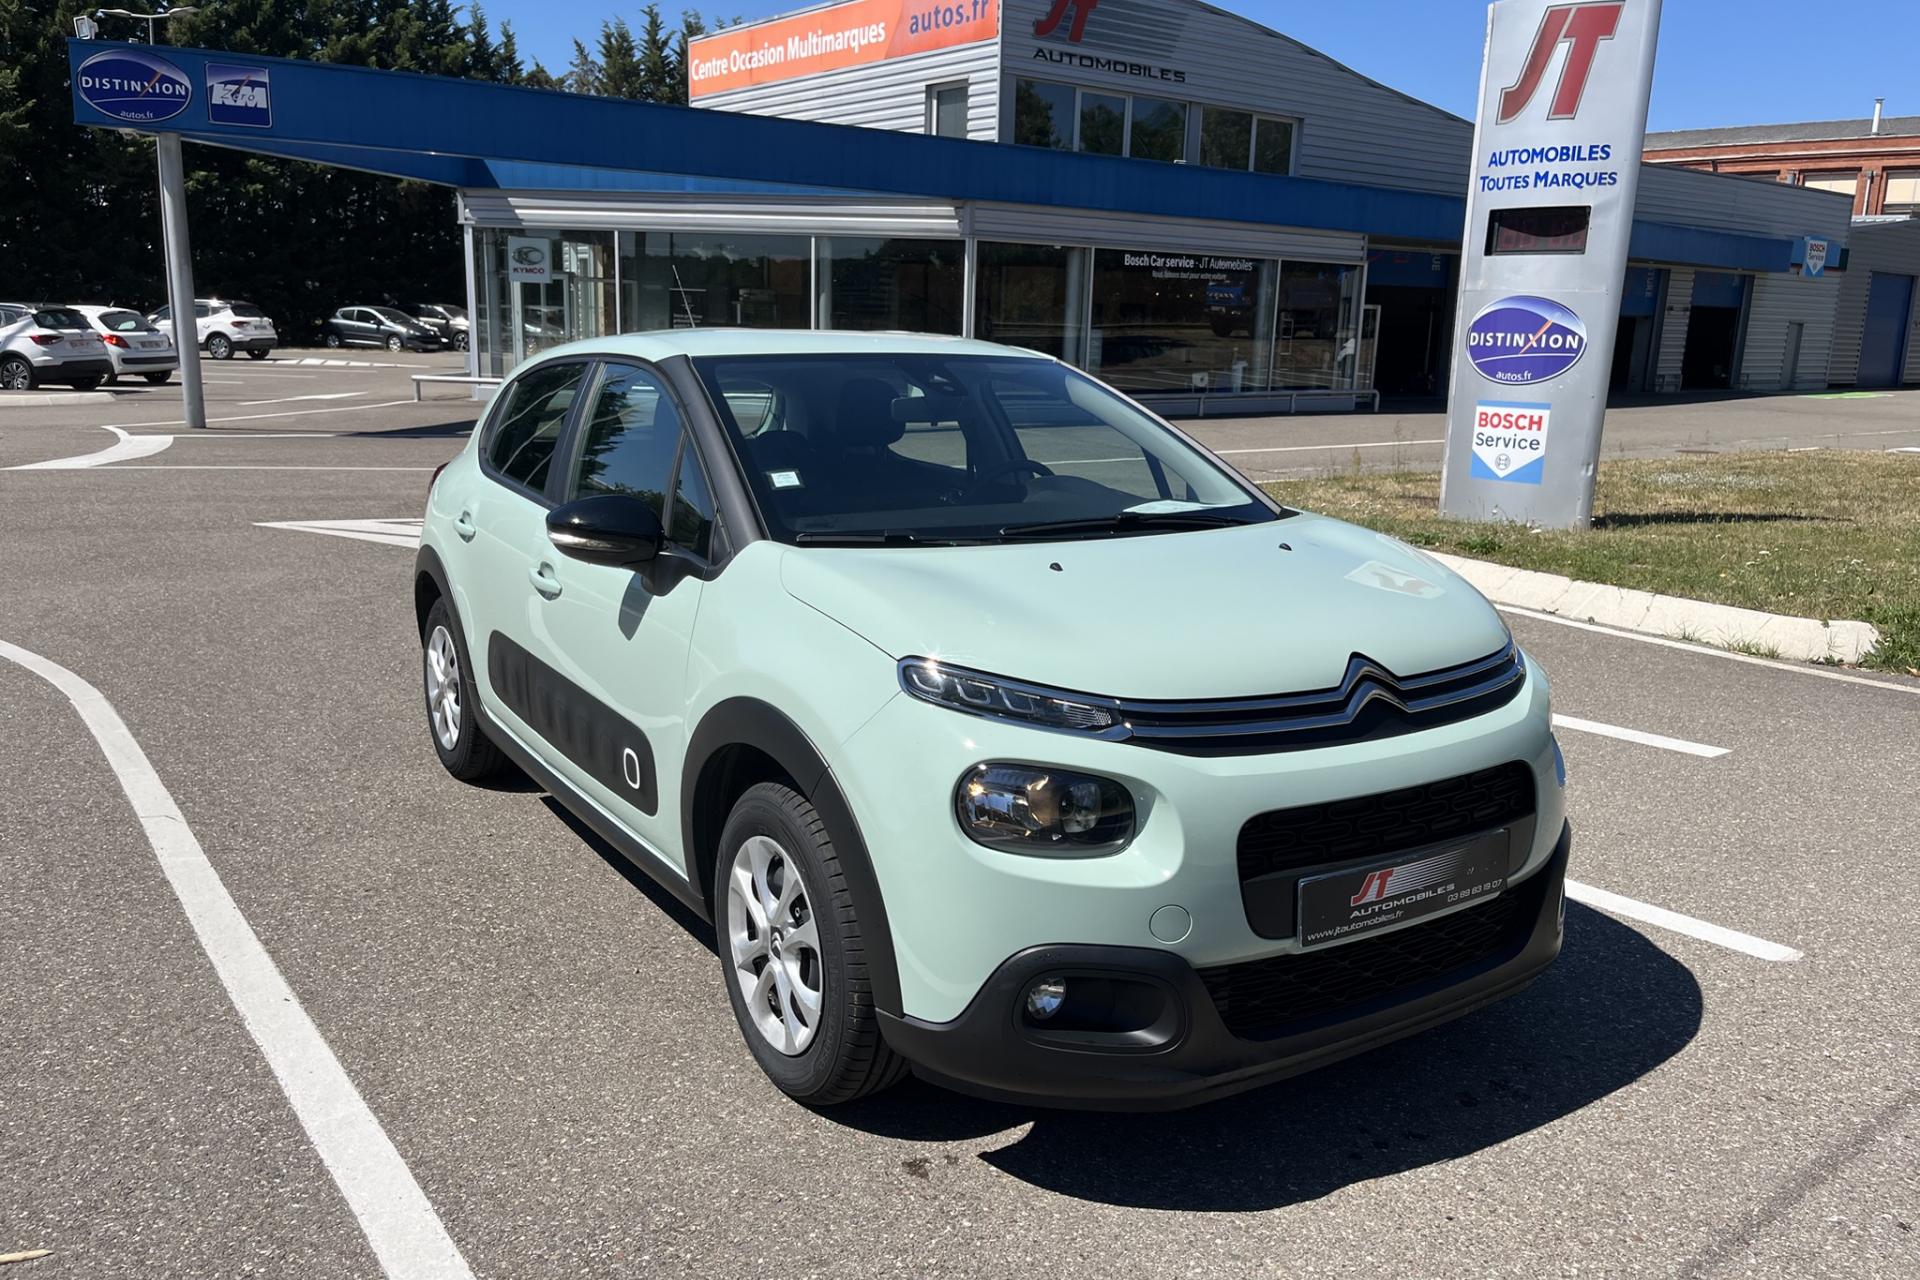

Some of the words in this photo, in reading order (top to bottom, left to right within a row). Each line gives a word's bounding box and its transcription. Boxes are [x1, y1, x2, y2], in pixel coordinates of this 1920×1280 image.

[909, 0, 989, 35] autos.fr
[691, 56, 728, 81] Centre
[730, 43, 784, 73] Occasion
[787, 21, 886, 61] Multimarques
[1496, 0, 1626, 125] JT
[1033, 48, 1186, 83] AUTOMOBILES
[81, 76, 187, 97] DISTINXION
[120, 109, 154, 120] autos.fr
[1488, 144, 1611, 168] AUTOMOBILES
[1124, 254, 1149, 266] Bosch
[1150, 255, 1165, 267] Car
[1165, 256, 1195, 268] service
[1199, 257, 1209, 269] JT
[1209, 258, 1253, 271] Automobiles
[1470, 330, 1579, 350] DISTINXION
[1496, 370, 1532, 382] autos.fr
[1478, 411, 1543, 432] BOSCH
[1475, 432, 1541, 451] Service
[1350, 868, 1395, 907] JT
[1447, 892, 1459, 903] 03
[1491, 879, 1503, 888] 07
[1350, 883, 1455, 919] AUTOMOBILES
[1307, 909, 1405, 942] www.jtautomobiles.fr
